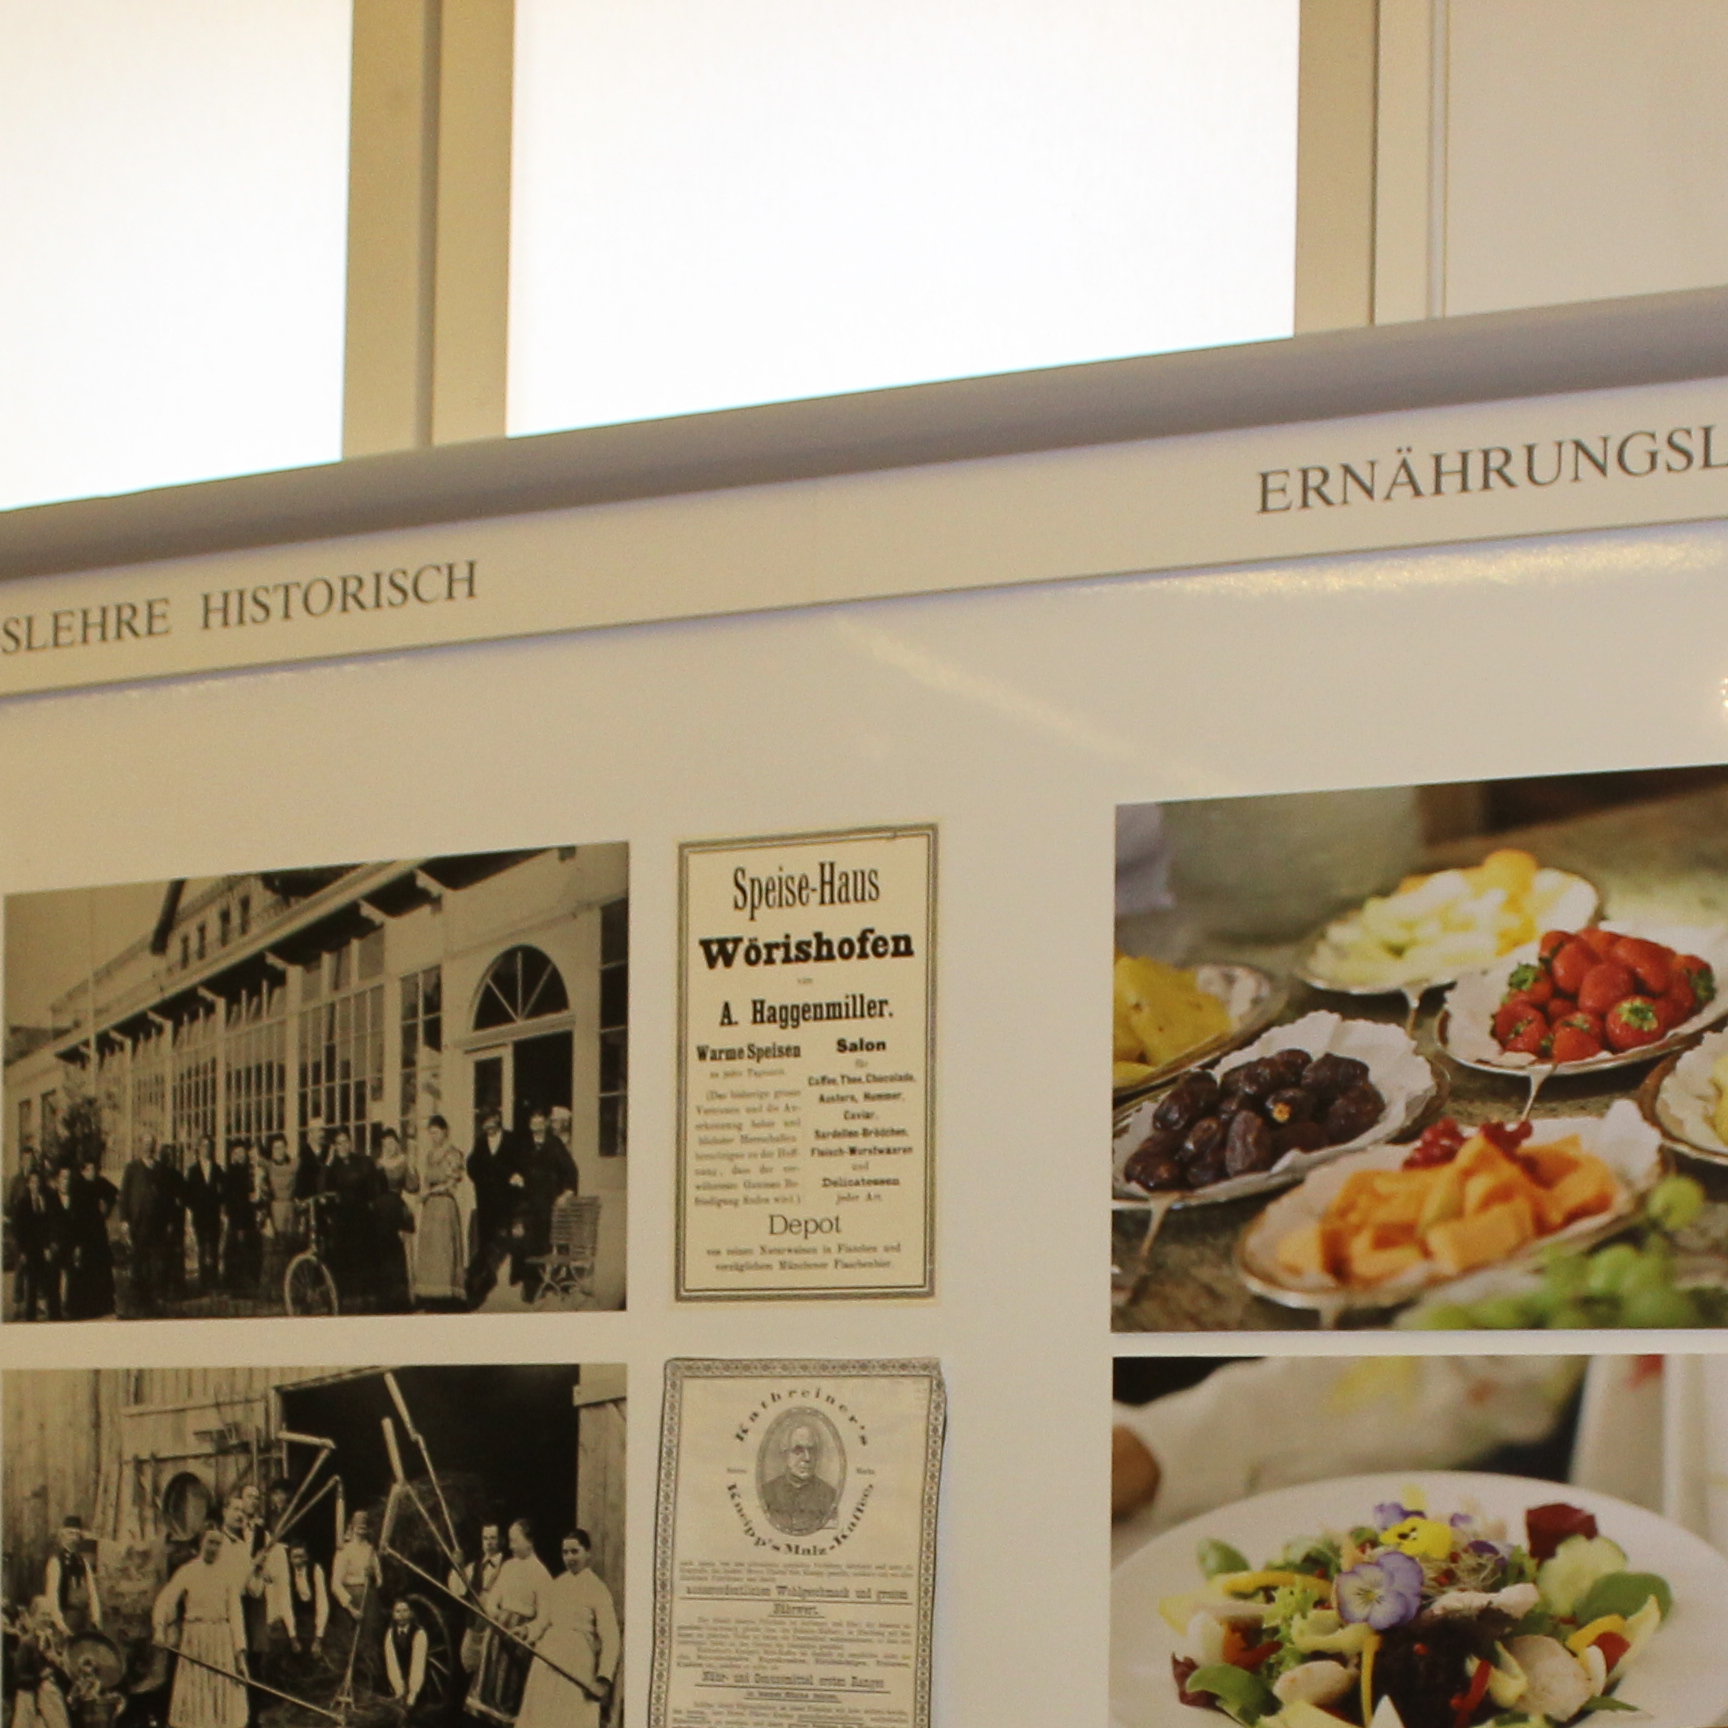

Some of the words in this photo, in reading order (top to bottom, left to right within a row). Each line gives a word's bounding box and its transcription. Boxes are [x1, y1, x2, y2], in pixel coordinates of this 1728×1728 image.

[200, 560, 478, 631] HISTORISCH
[733, 861, 880, 921] Speise-Haus
[699, 928, 914, 969] Wörishofen
[720, 1001, 738, 1027] A.
[751, 996, 894, 1028] Haggenmiller.
[697, 1044, 744, 1062] Warme
[747, 1043, 801, 1063] Speisen
[836, 1039, 887, 1054] Salon
[769, 1214, 842, 1240] Depot
